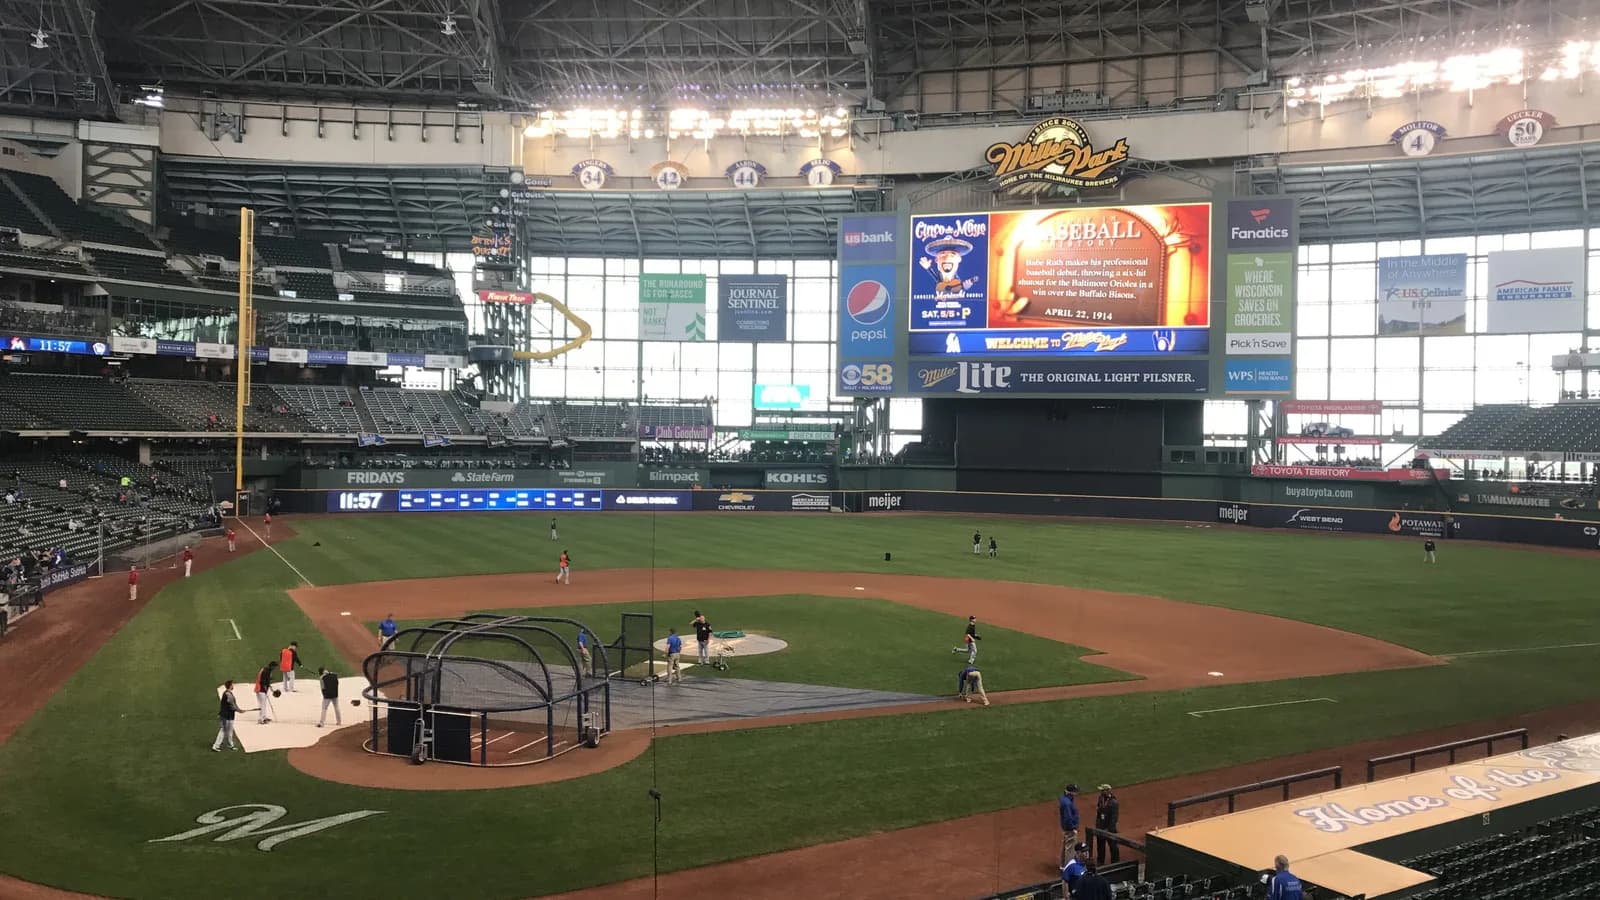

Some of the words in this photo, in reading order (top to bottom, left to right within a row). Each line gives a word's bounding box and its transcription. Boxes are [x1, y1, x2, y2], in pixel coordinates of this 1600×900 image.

[1507, 111, 1544, 122] UECKER
[1035, 119, 1060, 133] SINCE
[1061, 119, 1078, 131] 2001
[1399, 123, 1438, 134] MOLITOR
[1514, 121, 1536, 137] 50
[1410, 135, 1422, 151] 4
[986, 138, 1074, 177] Miller
[1055, 138, 1129, 178] Park
[524, 178, 552, 186] Gone!
[583, 171, 601, 185] 34
[659, 172, 678, 184] 42
[735, 172, 755, 184] 44
[817, 171, 823, 184] 1
[1000, 176, 1018, 187] HOME
[1045, 174, 1083, 186] MILWAUKEE
[1085, 176, 1119, 187] BREWERS
[1231, 226, 1289, 240] Fanatics
[1103, 257, 1148, 267] professional
[1387, 259, 1399, 269] In
[1401, 259, 1419, 268] the
[1421, 257, 1458, 267] Middle
[1056, 269, 1079, 277] debut,
[1081, 269, 1114, 278] throwing
[1244, 270, 1275, 284] WHERE
[1387, 270, 1400, 280] of
[1402, 267, 1457, 280] Anywhere
[643, 279, 657, 288] THE
[659, 279, 703, 289] RUNAROUND
[1046, 279, 1057, 287] for
[1058, 279, 1070, 287] the
[1071, 279, 1108, 287] Baltimore
[1109, 280, 1137, 288] Orioles
[1497, 286, 1540, 294] AMERICAN
[1542, 285, 1572, 293] FAMILY
[643, 290, 651, 298] IS
[652, 290, 667, 298] FOR
[728, 288, 779, 299] JOURNAL
[1065, 289, 1078, 297] the
[1079, 290, 1107, 298] Buffalo
[1108, 291, 1136, 299] Bisons.
[1234, 284, 1283, 298] WISCONSIN
[1403, 288, 1418, 298] US
[1420, 287, 1463, 298] Cellular
[728, 299, 779, 309] SENTINEL
[1239, 299, 1265, 312] SAVES
[1267, 299, 1279, 312] ON
[643, 308, 656, 316] NOT
[1045, 308, 1073, 317] APRIL
[1076, 310, 1089, 319] 22,
[1092, 311, 1113, 320] 1914
[1234, 313, 1282, 327] GROCERIES.
[851, 328, 887, 343] pepsi
[985, 337, 1049, 349] WELCOME
[1051, 339, 1061, 347] TO
[1062, 331, 1100, 350] Miller
[1094, 332, 1128, 352] Park
[40, 339, 72, 352] 11:57
[1230, 339, 1250, 348] Pick
[1261, 340, 1287, 348] Save
[861, 364, 893, 386] 58
[918, 366, 958, 388] Miller
[956, 361, 1010, 394] Lite
[1020, 373, 1044, 383] THE
[1047, 373, 1101, 383] ORIGINAL
[1104, 373, 1140, 383] LIGHT
[1142, 373, 1196, 384] PILSNER.
[1228, 370, 1254, 381] WPS
[655, 426, 672, 439] Club
[675, 426, 708, 439] Goodwill
[347, 471, 404, 484] FRIDAYS
[766, 472, 828, 483] KOHL'S
[1270, 467, 1303, 476] TOYOTA
[1305, 468, 1351, 477] TERRITORY
[1286, 486, 1353, 499] buyatoyota.com
[339, 492, 383, 509] 11:57
[868, 493, 901, 510] meijer
[1219, 505, 1248, 523] meijer
[1297, 796, 1442, 832] Home
[1446, 775, 1498, 801] of
[1491, 768, 1556, 788] the
